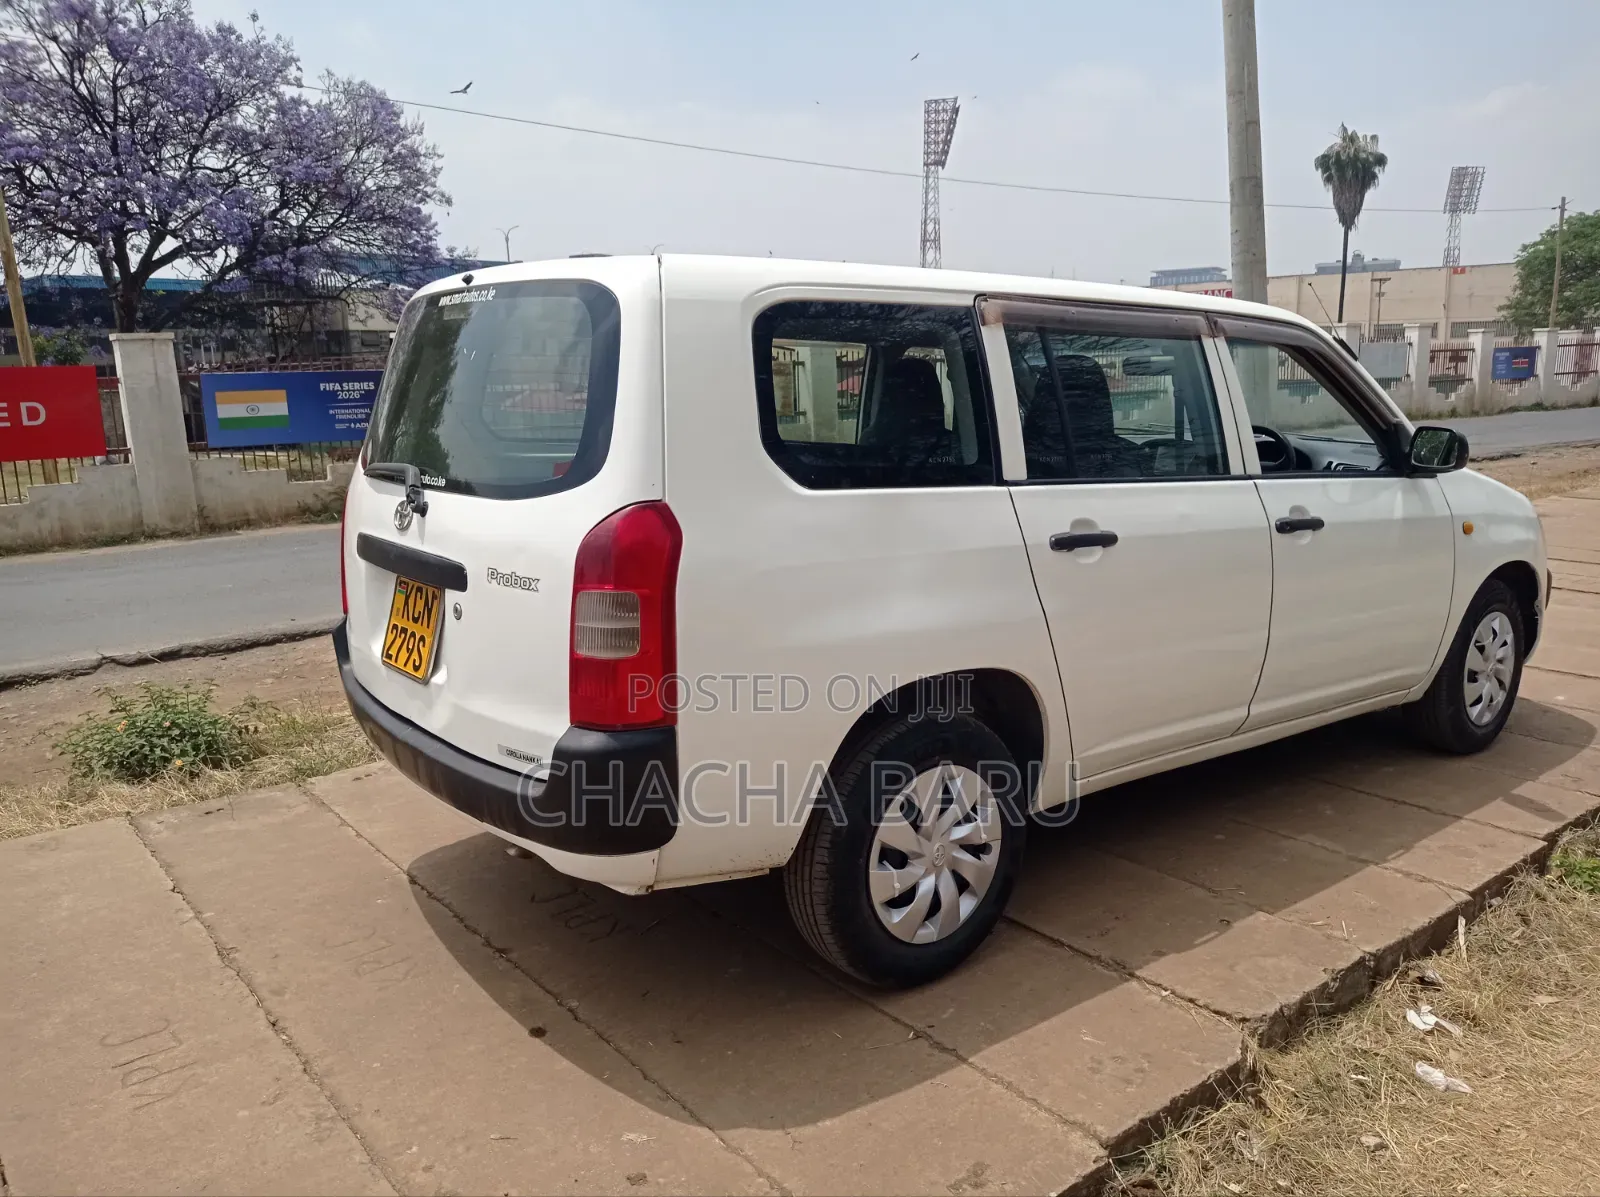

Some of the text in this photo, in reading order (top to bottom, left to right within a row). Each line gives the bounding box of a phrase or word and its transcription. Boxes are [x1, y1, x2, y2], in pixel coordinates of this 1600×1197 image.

[320, 381, 375, 391] FIFA SERIES
[487, 567, 541, 592] Probox
[401, 583, 436, 629] KCN
[384, 623, 426, 673] 279S
